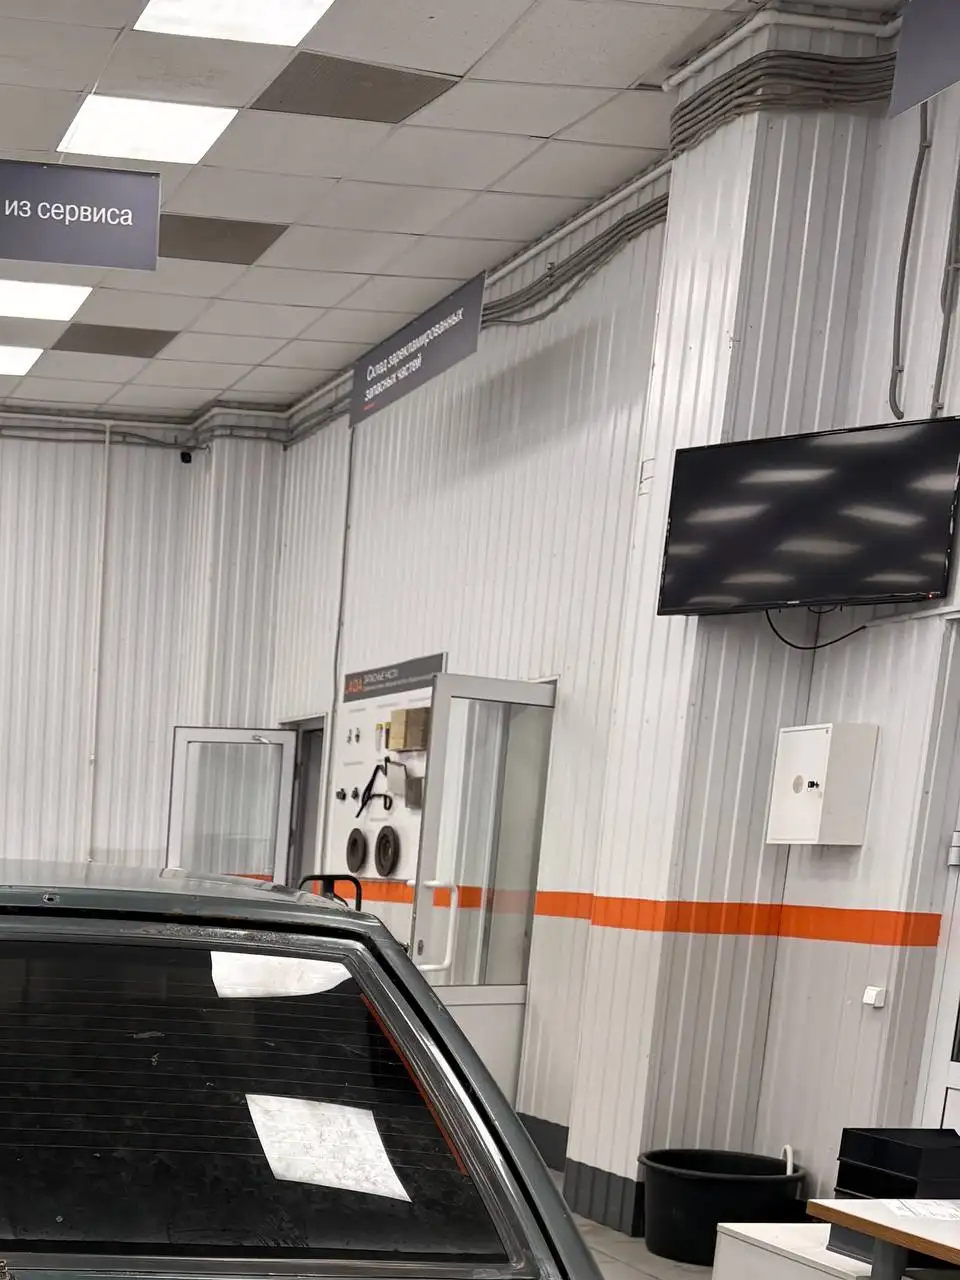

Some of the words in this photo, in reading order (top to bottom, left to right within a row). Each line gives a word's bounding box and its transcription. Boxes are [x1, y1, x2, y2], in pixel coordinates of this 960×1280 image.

[5, 199, 32, 218] из
[37, 202, 133, 226] сервиса
[364, 370, 397, 402] запасных
[397, 352, 422, 381] частей
[366, 358, 388, 382] Склад
